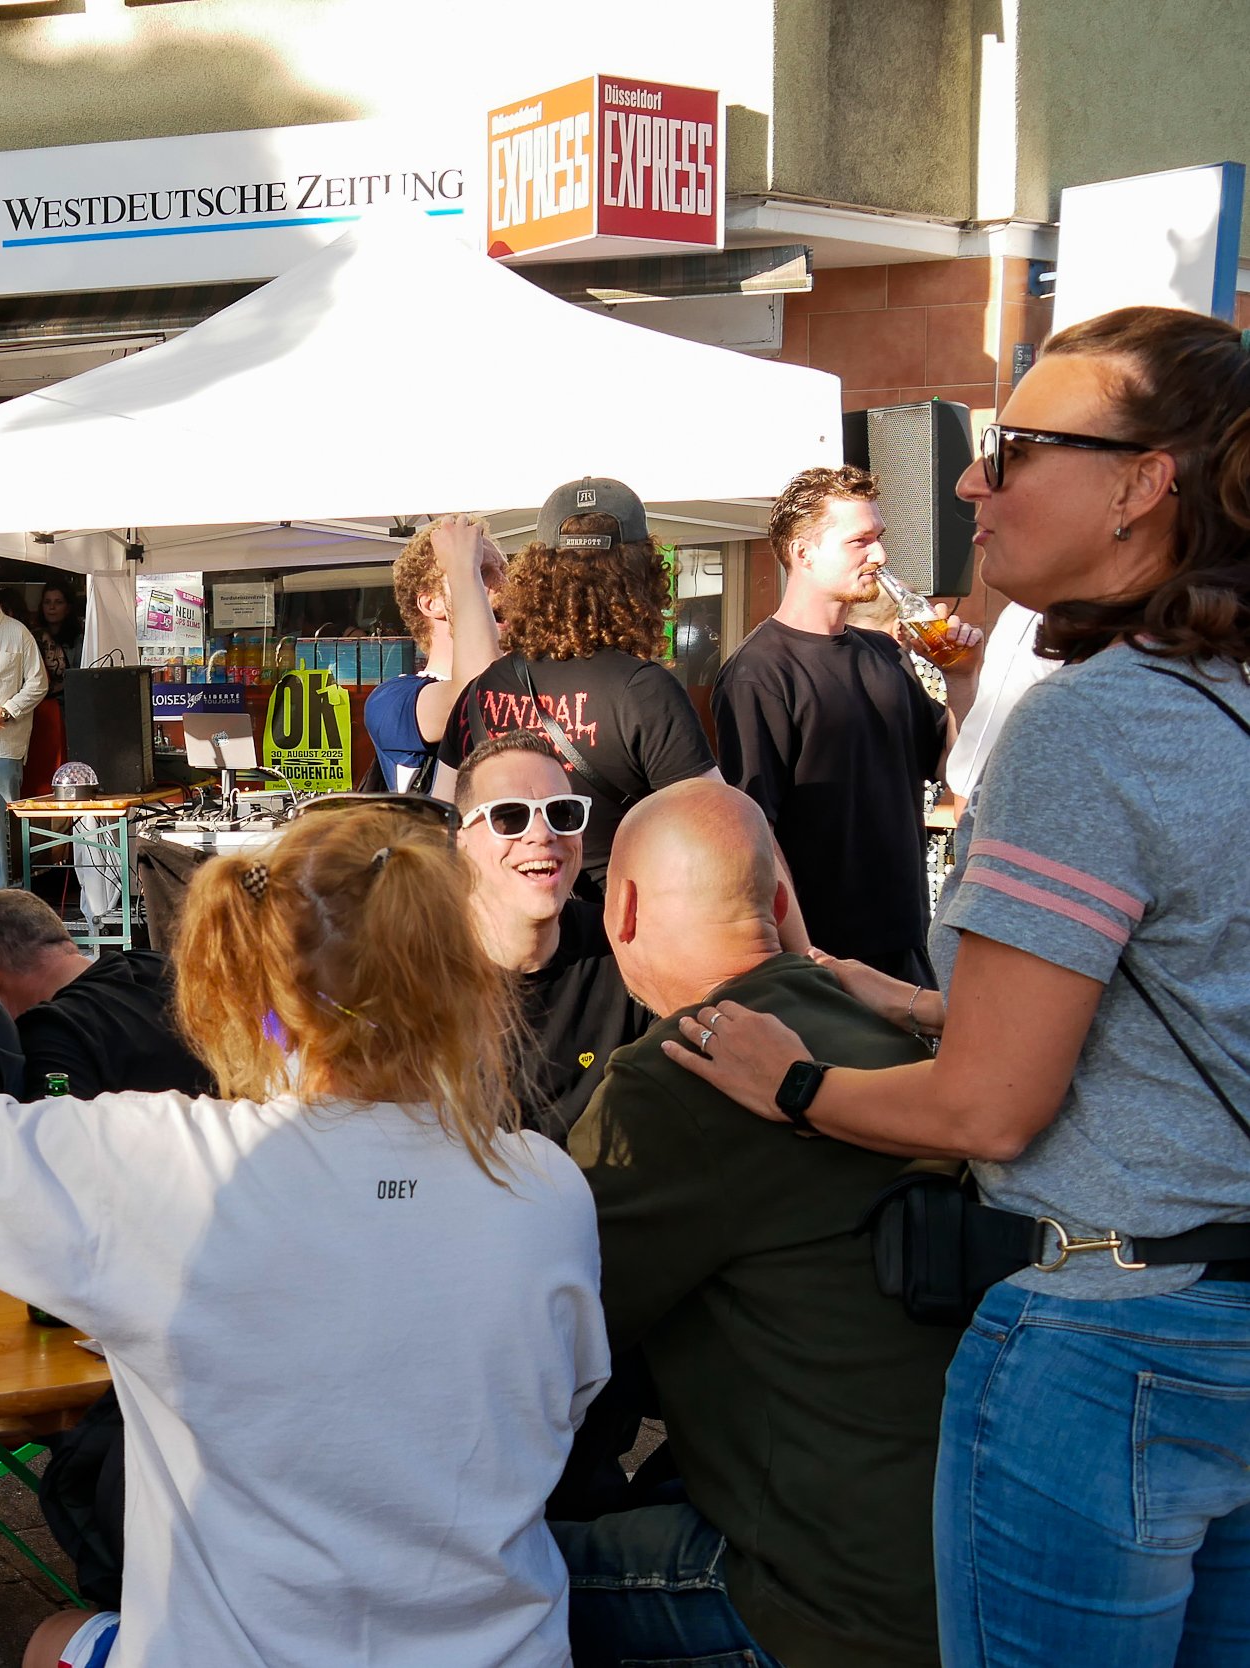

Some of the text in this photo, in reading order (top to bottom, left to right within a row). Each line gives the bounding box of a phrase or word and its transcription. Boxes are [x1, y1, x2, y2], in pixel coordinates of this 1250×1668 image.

[604, 84, 662, 110] Düsseldorf
[491, 112, 590, 232] EXPRESS
[604, 110, 713, 216] EXPRESS
[2, 181, 287, 232] WESTDEUTSCHE
[566, 538, 602, 546] RUHRPOTT
[175, 605, 195, 621] NEU!
[186, 619, 201, 629] SLIMS
[271, 673, 343, 750] OK
[271, 750, 343, 758] 30. AUGUST 2025
[377, 1179, 418, 1200] OBEY
